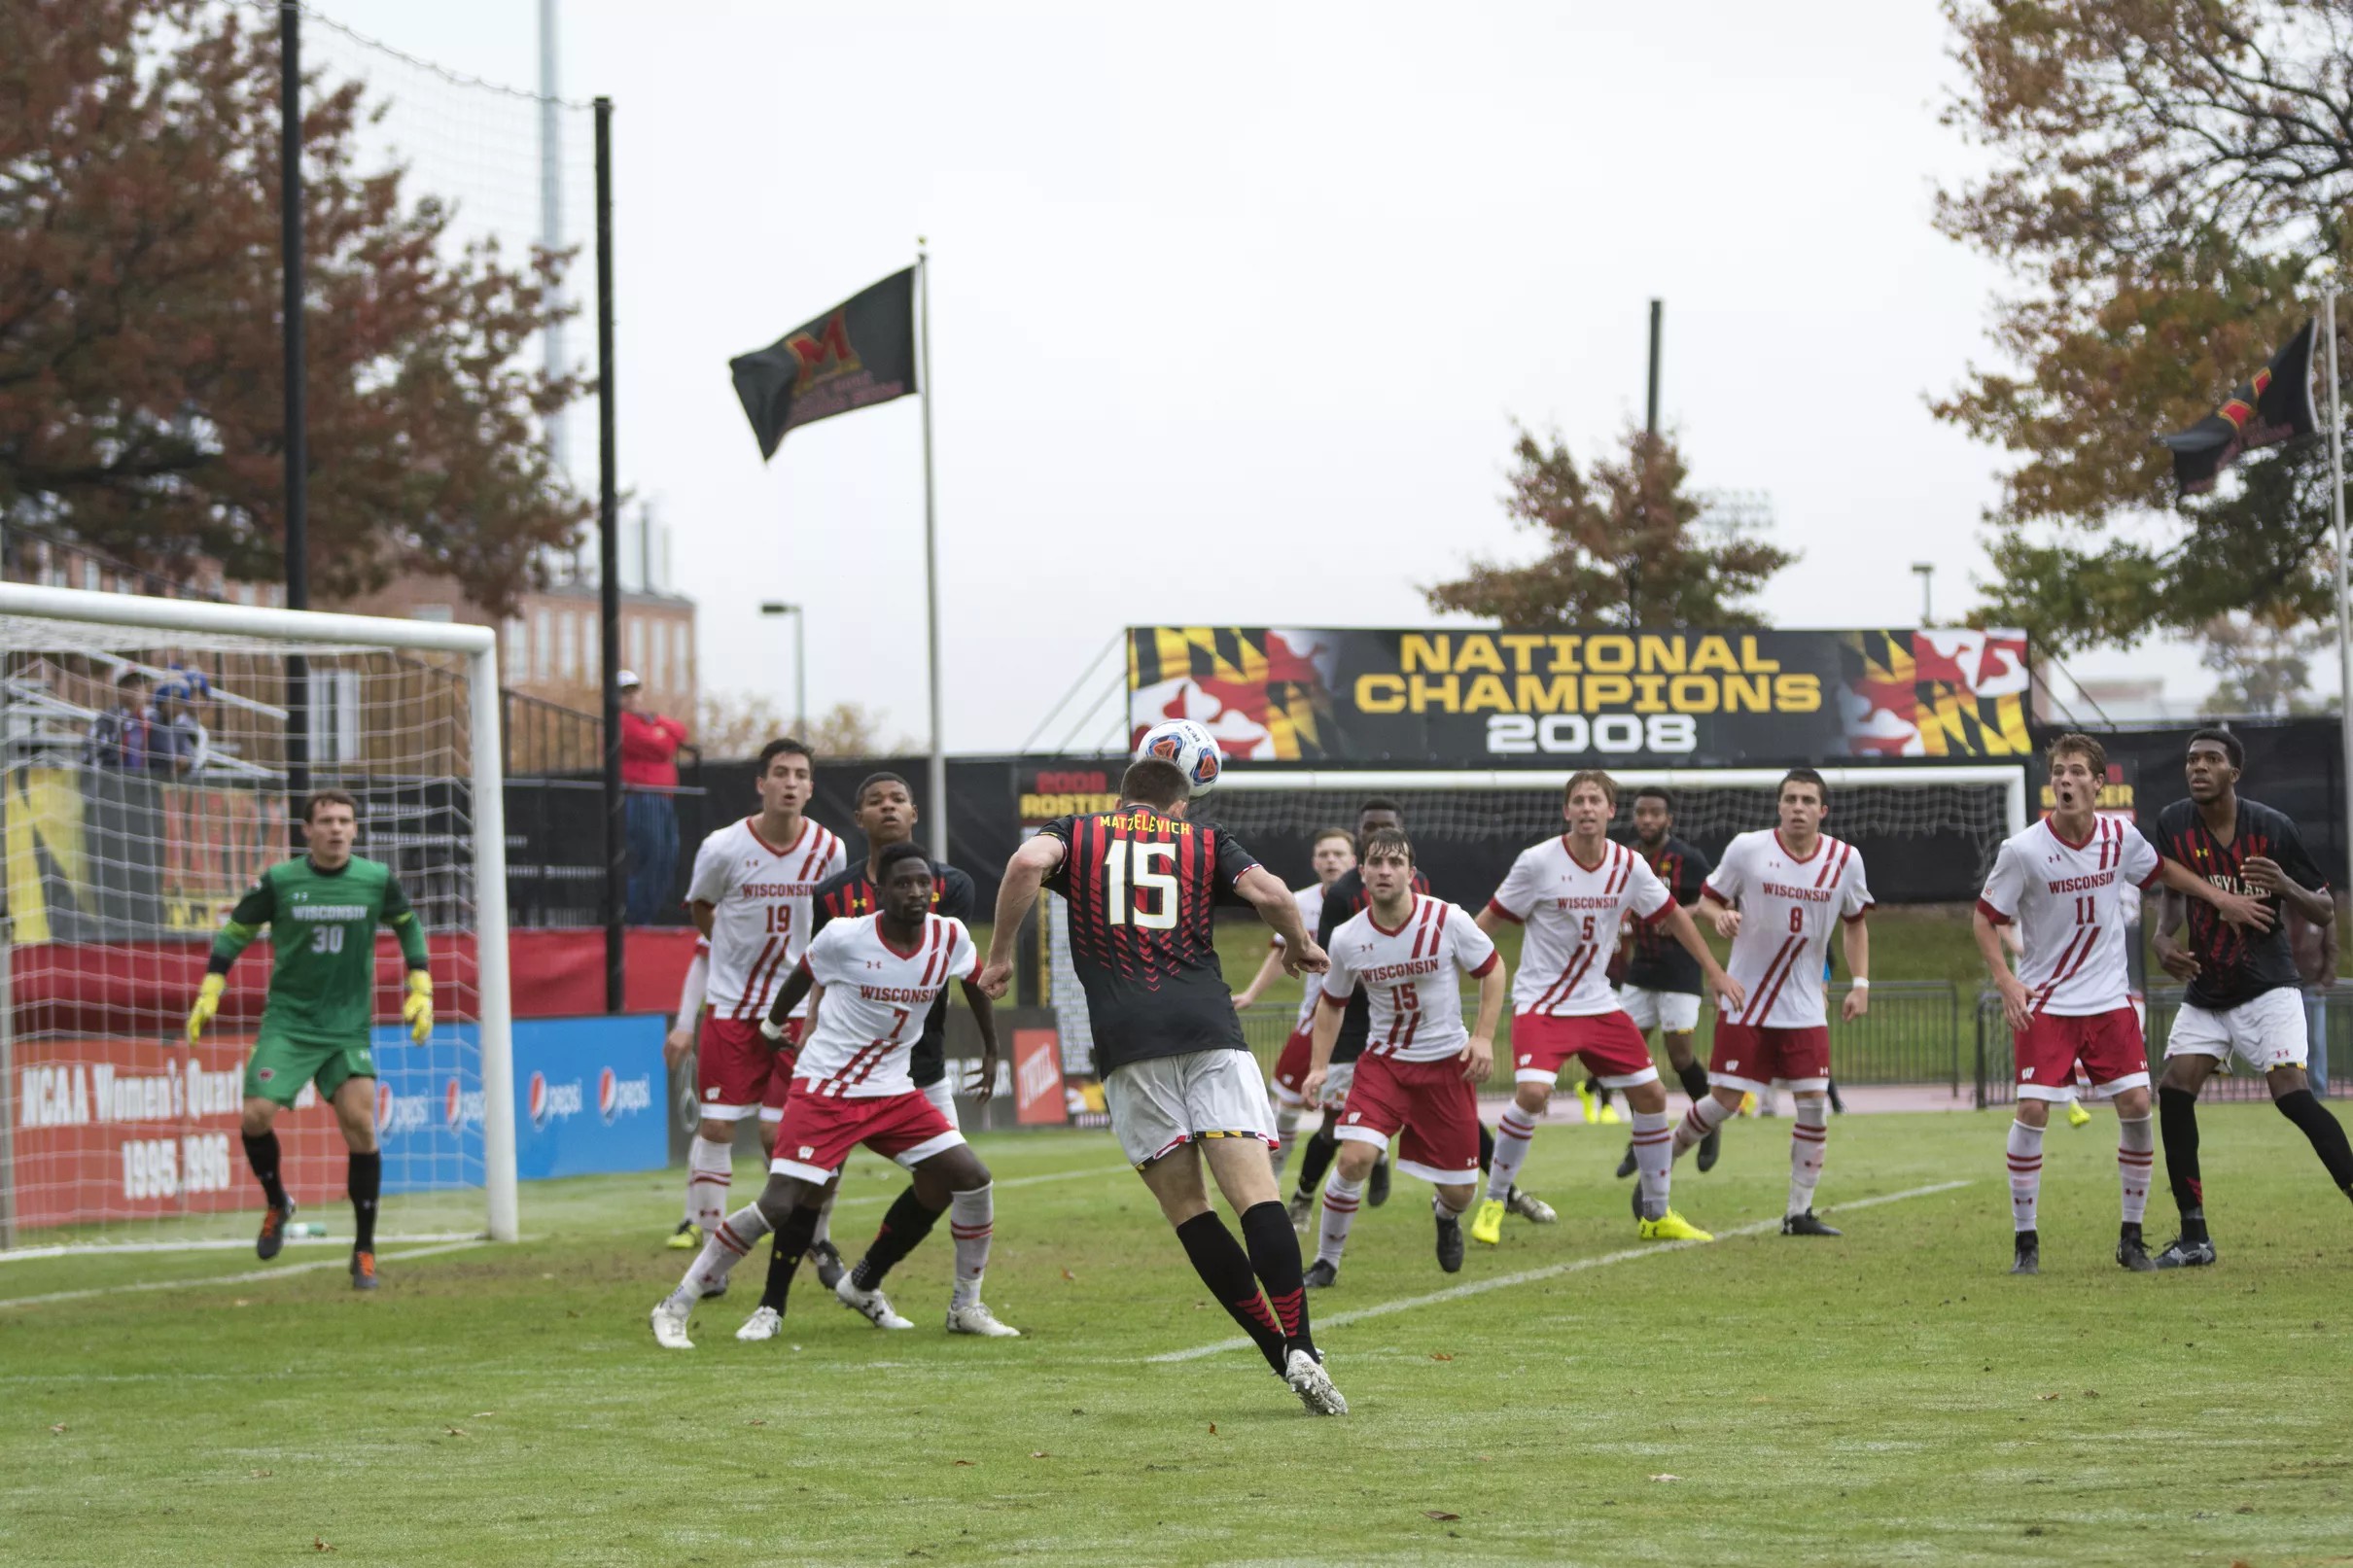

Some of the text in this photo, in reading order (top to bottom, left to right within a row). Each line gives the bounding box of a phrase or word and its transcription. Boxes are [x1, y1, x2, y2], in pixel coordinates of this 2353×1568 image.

[1400, 634, 1780, 674] NATIONAL
[1354, 674, 1822, 714] CHAMPIONS
[1486, 714, 1698, 753] 2008
[1100, 814, 1191, 835] MATZELEVICH
[742, 883, 816, 897] WISCONSIN
[1104, 839, 1179, 930] 15
[1763, 882, 1833, 902] WISCONSIN
[2049, 870, 2116, 894] WISCONSIN
[292, 905, 369, 922] WISCONSIN
[1558, 896, 1620, 910] WISCONSIN
[2075, 895, 2095, 925] 11
[765, 904, 792, 934] 19
[1582, 916, 1596, 941] 5
[1790, 906, 1804, 934] 8
[311, 924, 344, 955] 30
[1361, 958, 1439, 984] WISCONSIN
[1389, 982, 1420, 1012] 15
[891, 1008, 910, 1039] 7
[21, 1063, 89, 1127] NCAA
[92, 1057, 184, 1124] Women's
